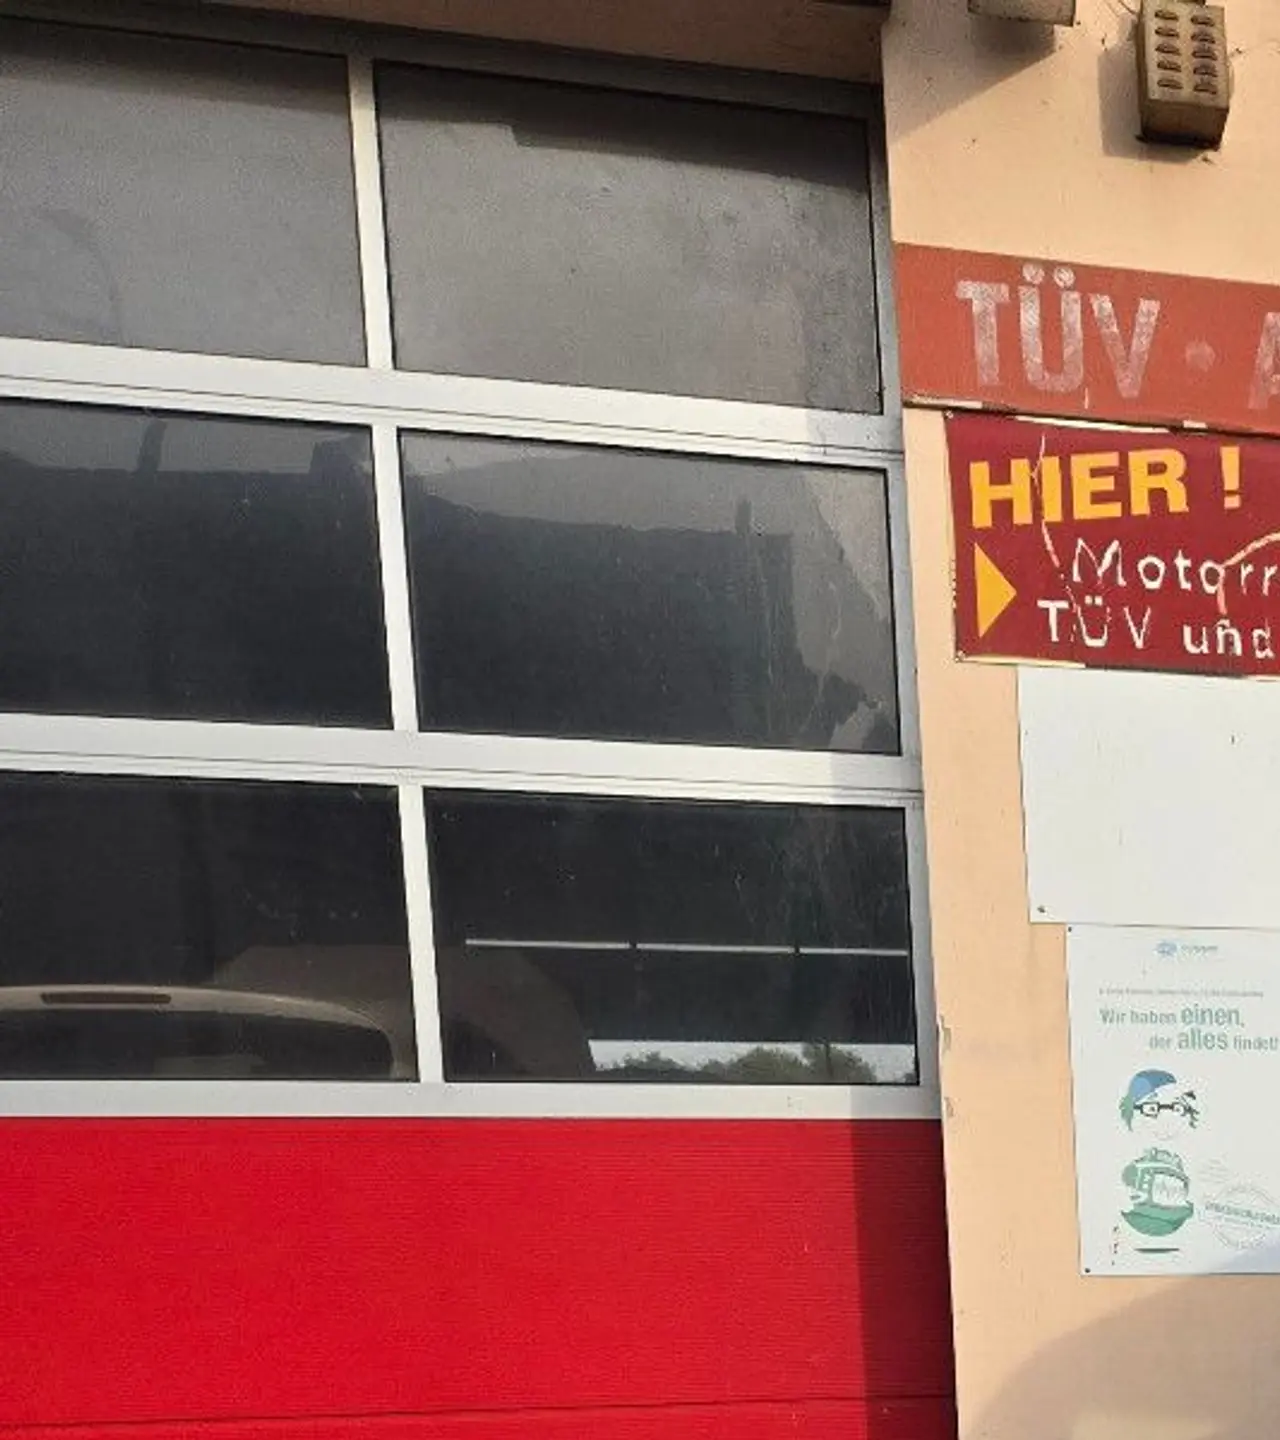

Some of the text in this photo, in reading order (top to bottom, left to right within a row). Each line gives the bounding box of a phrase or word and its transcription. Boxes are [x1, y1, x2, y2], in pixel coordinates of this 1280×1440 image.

[956, 263, 1160, 399] TÜV
[968, 448, 1189, 529] HIER
[1036, 596, 1153, 650] TÜV
[1182, 619, 1273, 659] und
[1099, 1003, 1245, 1028] Wir haben einen,
[1177, 1027, 1229, 1051] alles
